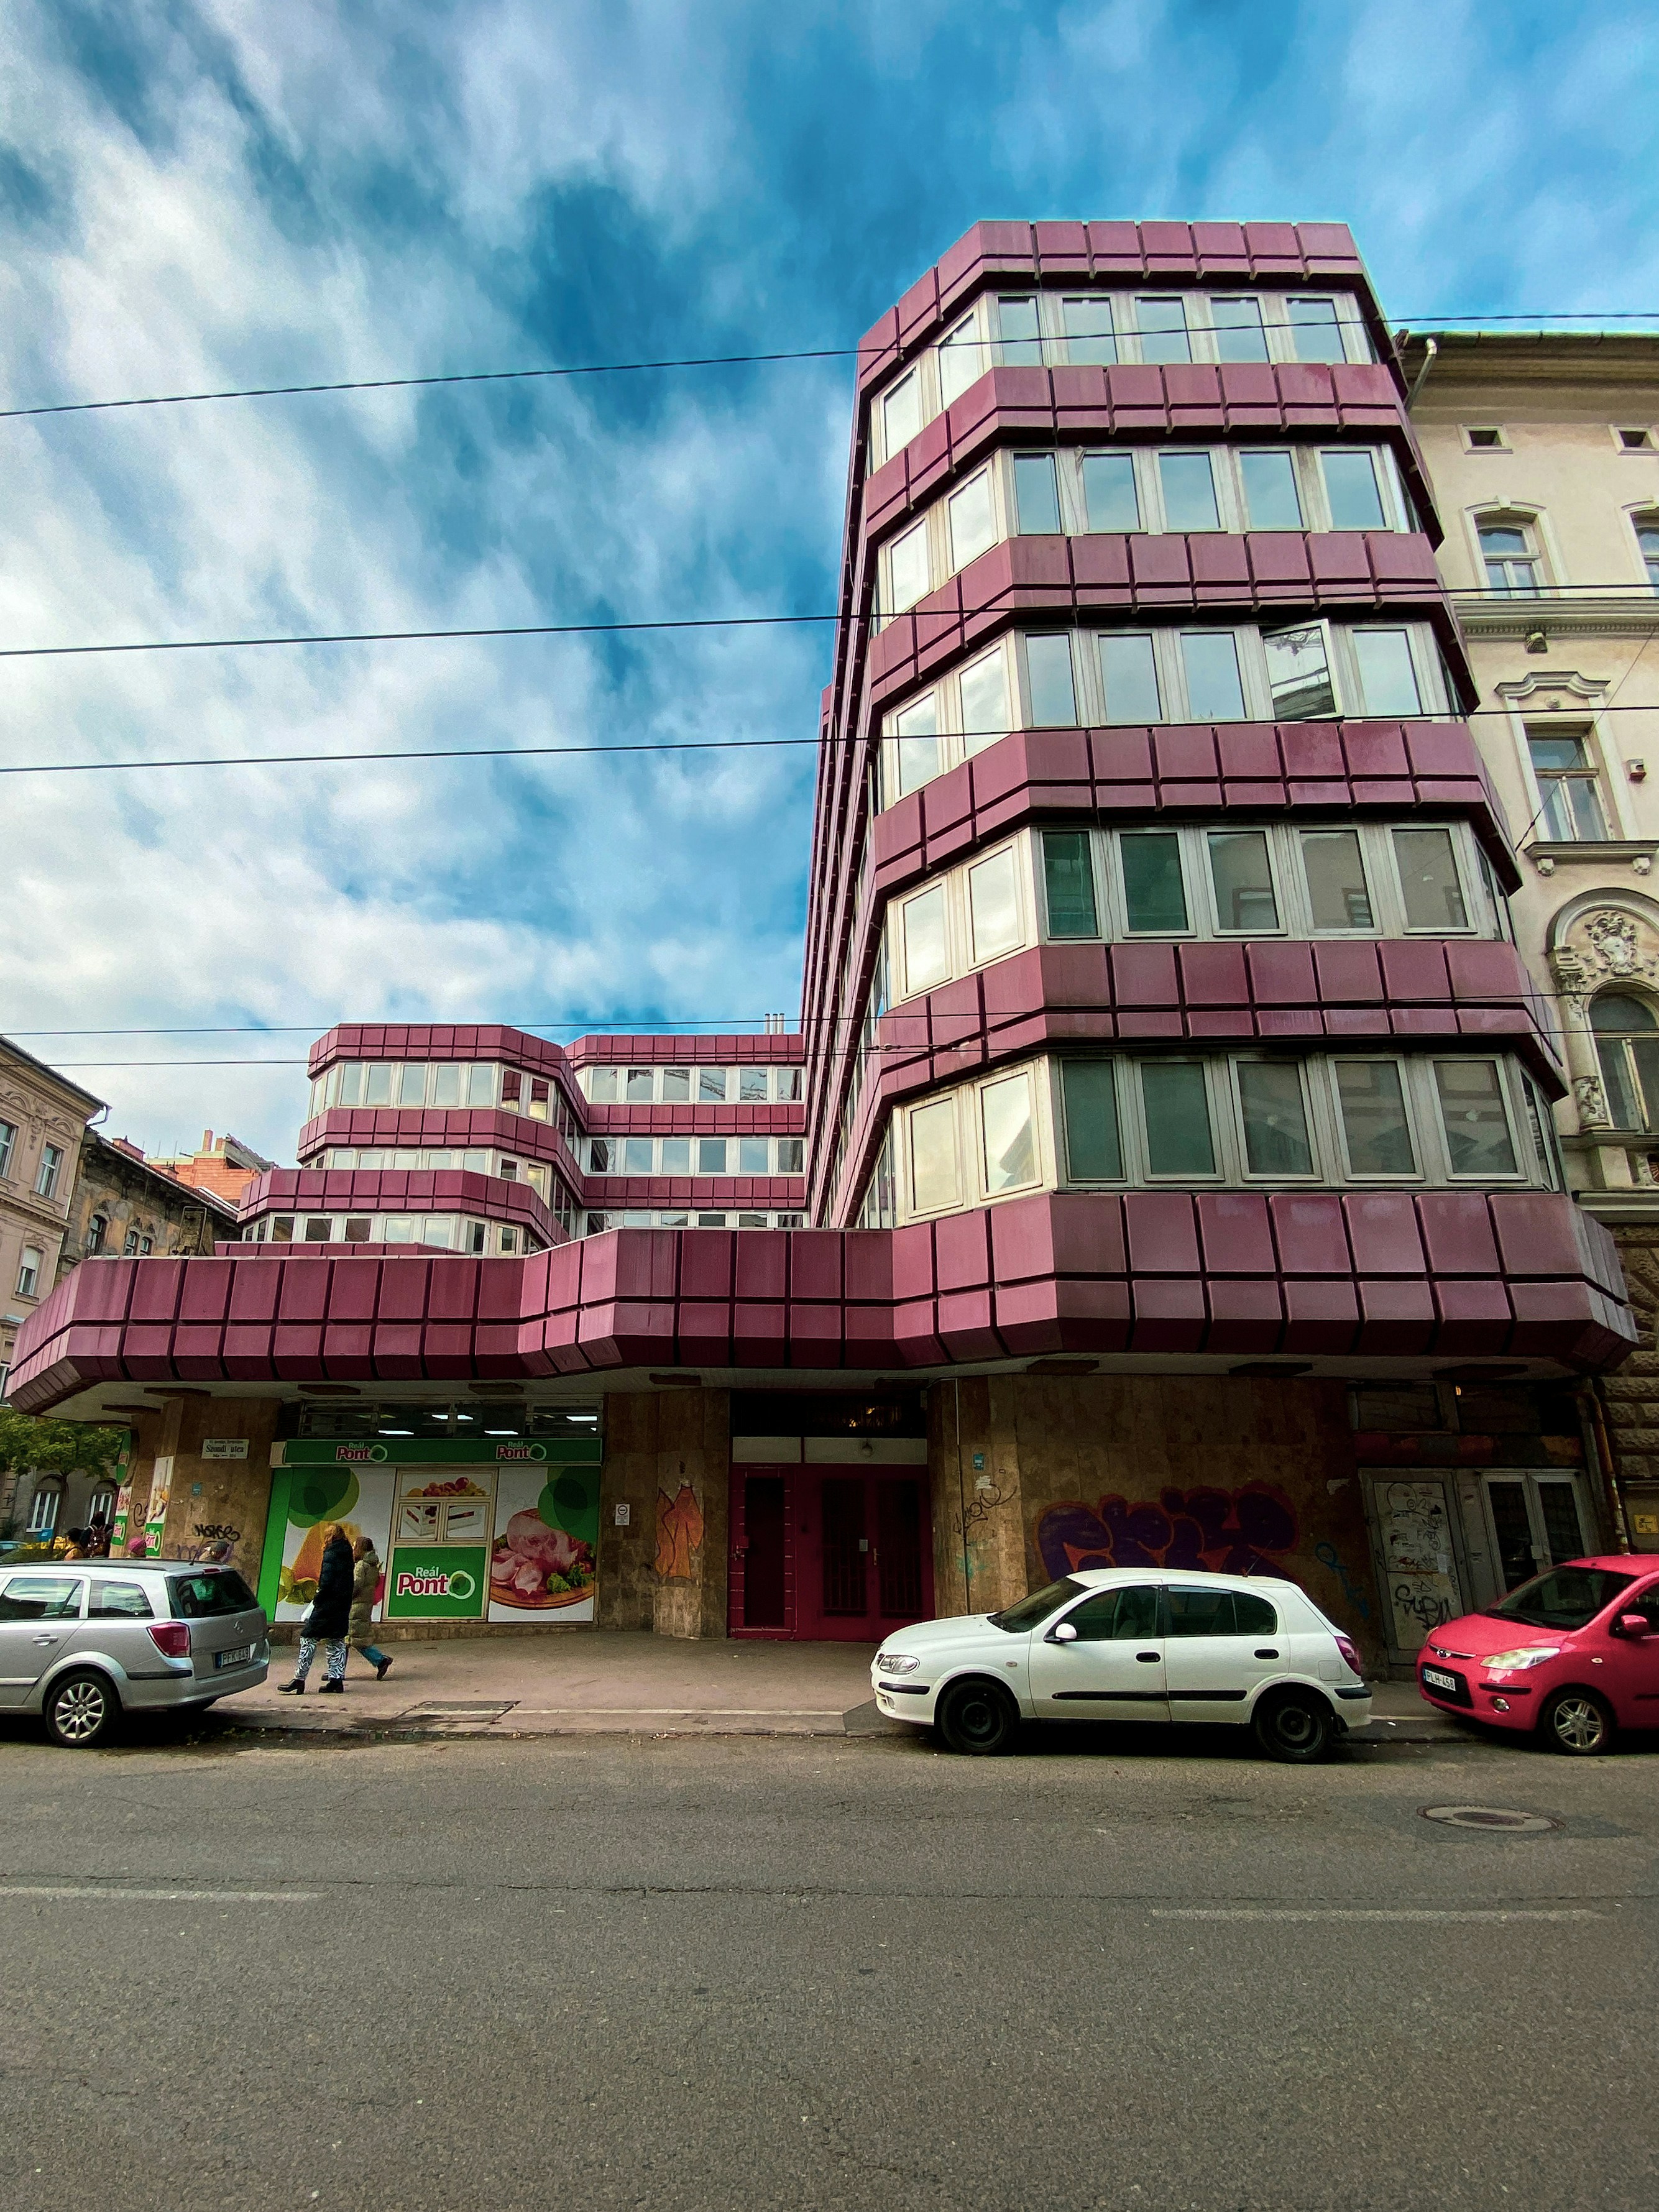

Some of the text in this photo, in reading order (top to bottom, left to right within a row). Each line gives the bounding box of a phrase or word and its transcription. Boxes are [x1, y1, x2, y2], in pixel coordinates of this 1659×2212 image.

[336, 1446, 371, 1461] Pont
[496, 1445, 530, 1459] Pont
[415, 1566, 439, 1577] Reál
[397, 1572, 448, 1596] Pont
[1427, 1671, 1454, 1689] PLH-458
